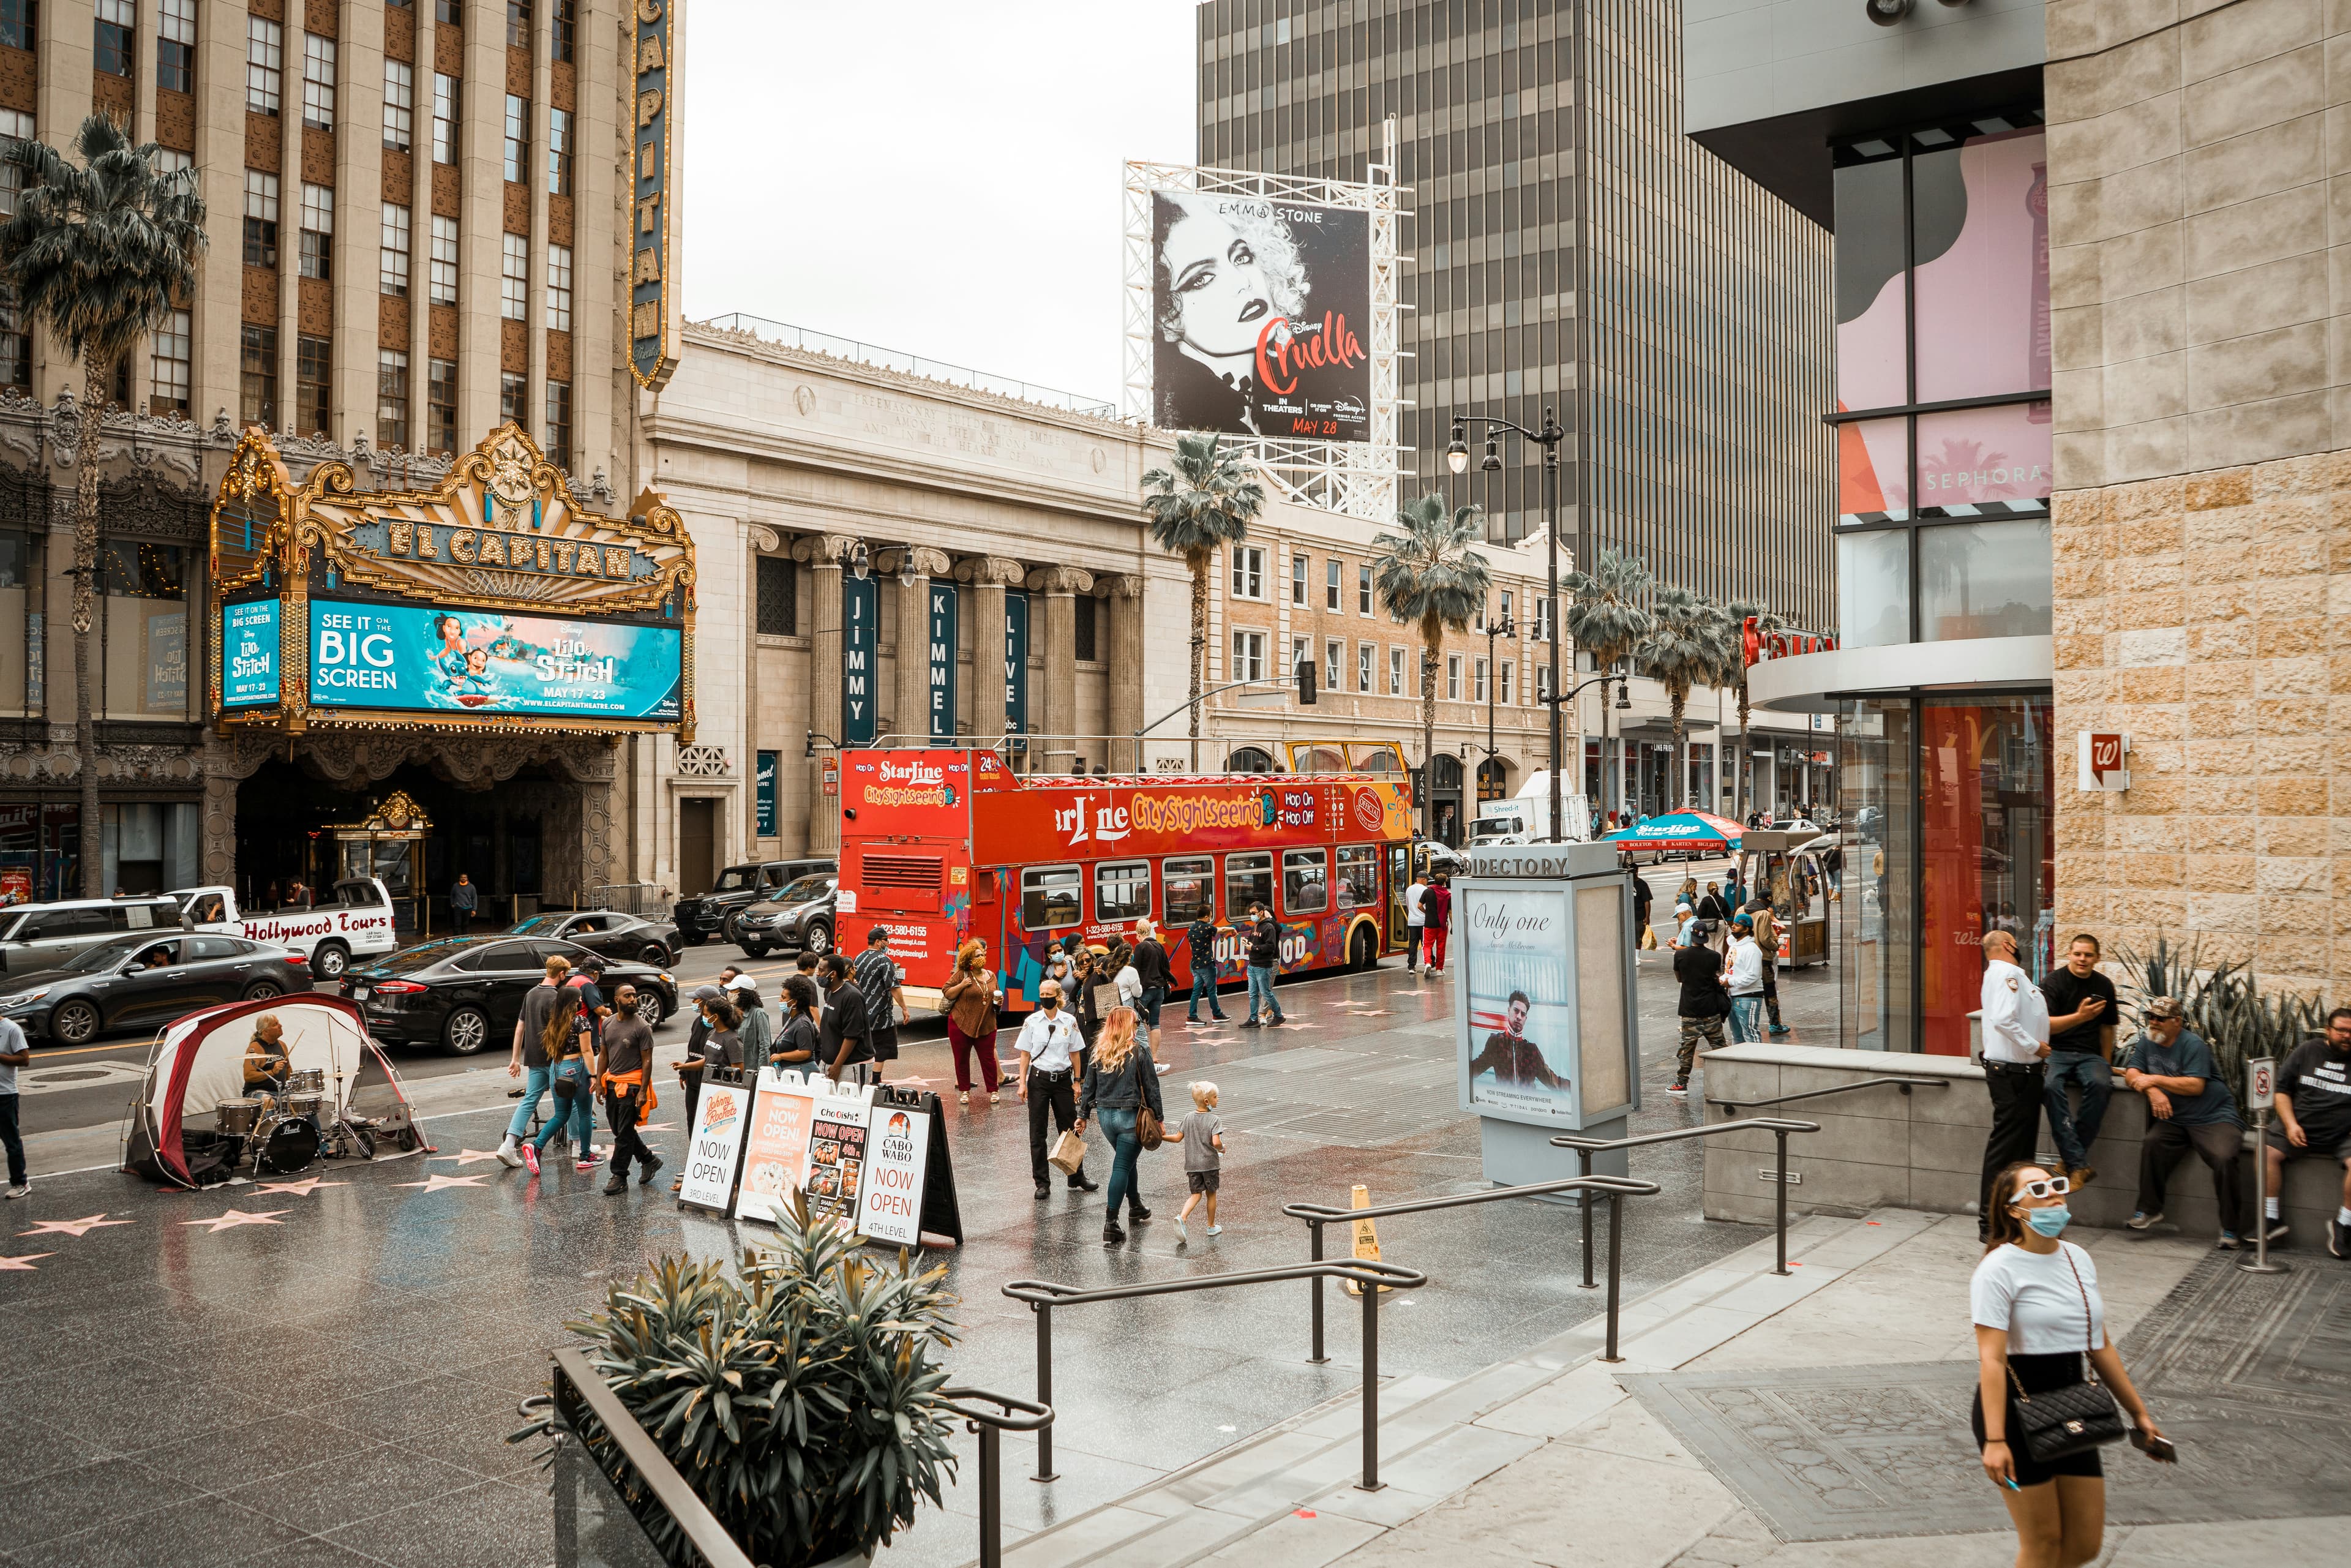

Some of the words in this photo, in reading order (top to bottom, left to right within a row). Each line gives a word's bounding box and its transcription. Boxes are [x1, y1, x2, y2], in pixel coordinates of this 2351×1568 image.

[1219, 203, 1269, 217] EMMA
[1276, 208, 1322, 223] STONE
[632, 345, 661, 362] Theatre
[1256, 310, 1367, 395] Cruella
[855, 394, 937, 419] FREEMASONRY
[947, 413, 986, 430] BUILDS
[1262, 403, 1303, 415] THEATERS
[895, 416, 936, 432] AMONG
[947, 426, 968, 439] THE
[980, 432, 1027, 451] NATIONS
[1292, 418, 1318, 436] MAY
[1322, 421, 1337, 435] 28
[863, 422, 888, 435] AND
[901, 429, 914, 441] IN
[925, 433, 947, 447] THE
[959, 440, 1000, 457] HEARTS
[1927, 465, 2044, 490] SEPHORA
[499, 508, 525, 530] The
[389, 522, 440, 558] EL
[450, 529, 631, 579] CAPITAN
[465, 569, 555, 600] Theatre
[233, 618, 244, 628] BIG
[245, 613, 271, 626] SCREEN
[321, 613, 352, 629] SEE
[358, 616, 372, 630] IT
[318, 630, 395, 667] BIG
[848, 596, 865, 721] JIMMY
[930, 595, 947, 734] KIMMEL
[1005, 615, 1016, 703] LIVE
[236, 684, 248, 693] MAY
[249, 683, 255, 692] 17
[259, 682, 266, 691] 23
[317, 668, 397, 690] SCREEN
[544, 687, 569, 699] MAY
[571, 688, 584, 699] 17
[592, 689, 606, 700] 23
[523, 699, 625, 711] WWW.ELCAPITANTHEATRE.COM
[855, 764, 866, 773] Hop
[879, 760, 944, 786] StarLine
[948, 764, 959, 773] Hop
[980, 756, 992, 772] 24
[864, 785, 946, 807] CitySightseeing
[1285, 792, 1301, 807] Hop
[1302, 791, 1314, 806] On
[1367, 788, 1378, 800] TOUR
[1131, 792, 1264, 834] CitySightseeing
[1286, 810, 1301, 825] Hop
[1302, 809, 1314, 825] Off
[1359, 798, 1379, 818] OFFICIAL
[1494, 805, 1519, 813] Shred-it
[1358, 812, 1367, 827] SANTA
[1463, 858, 1568, 875] DIRECTORY
[244, 917, 332, 943] Hollywood
[338, 913, 386, 931] Tours
[1086, 923, 1123, 934] 1-323-580-6155
[1474, 902, 1513, 939] Only
[1517, 917, 1552, 931] one
[1212, 936, 1306, 964] OLLOD
[1507, 941, 1535, 950] McBroom
[707, 1093, 734, 1112] Johnny
[1496, 1091, 1520, 1100] STREAMING
[1521, 1095, 1552, 1104] EVERYWHERE
[703, 1106, 737, 1126] Rockets
[768, 1106, 800, 1125] NOW
[820, 1108, 835, 1118] Cho
[836, 1110, 854, 1121] Oishi
[280, 1124, 301, 1135] Pearl
[762, 1123, 801, 1142] OPEN!
[814, 1122, 839, 1139] NOW
[839, 1127, 865, 1143] OPEN
[698, 1139, 731, 1161] NOW
[842, 1142, 856, 1156] 4th
[883, 1138, 913, 1152] CABO
[882, 1149, 912, 1162] WABO
[692, 1162, 727, 1184] OPEN
[875, 1167, 914, 1190] NOW
[689, 1188, 701, 1199] 3RD
[702, 1191, 719, 1204] LEVEL
[871, 1193, 912, 1217] OPEN
[869, 1222, 884, 1234] 4TH
[885, 1225, 907, 1239] LEVEL
